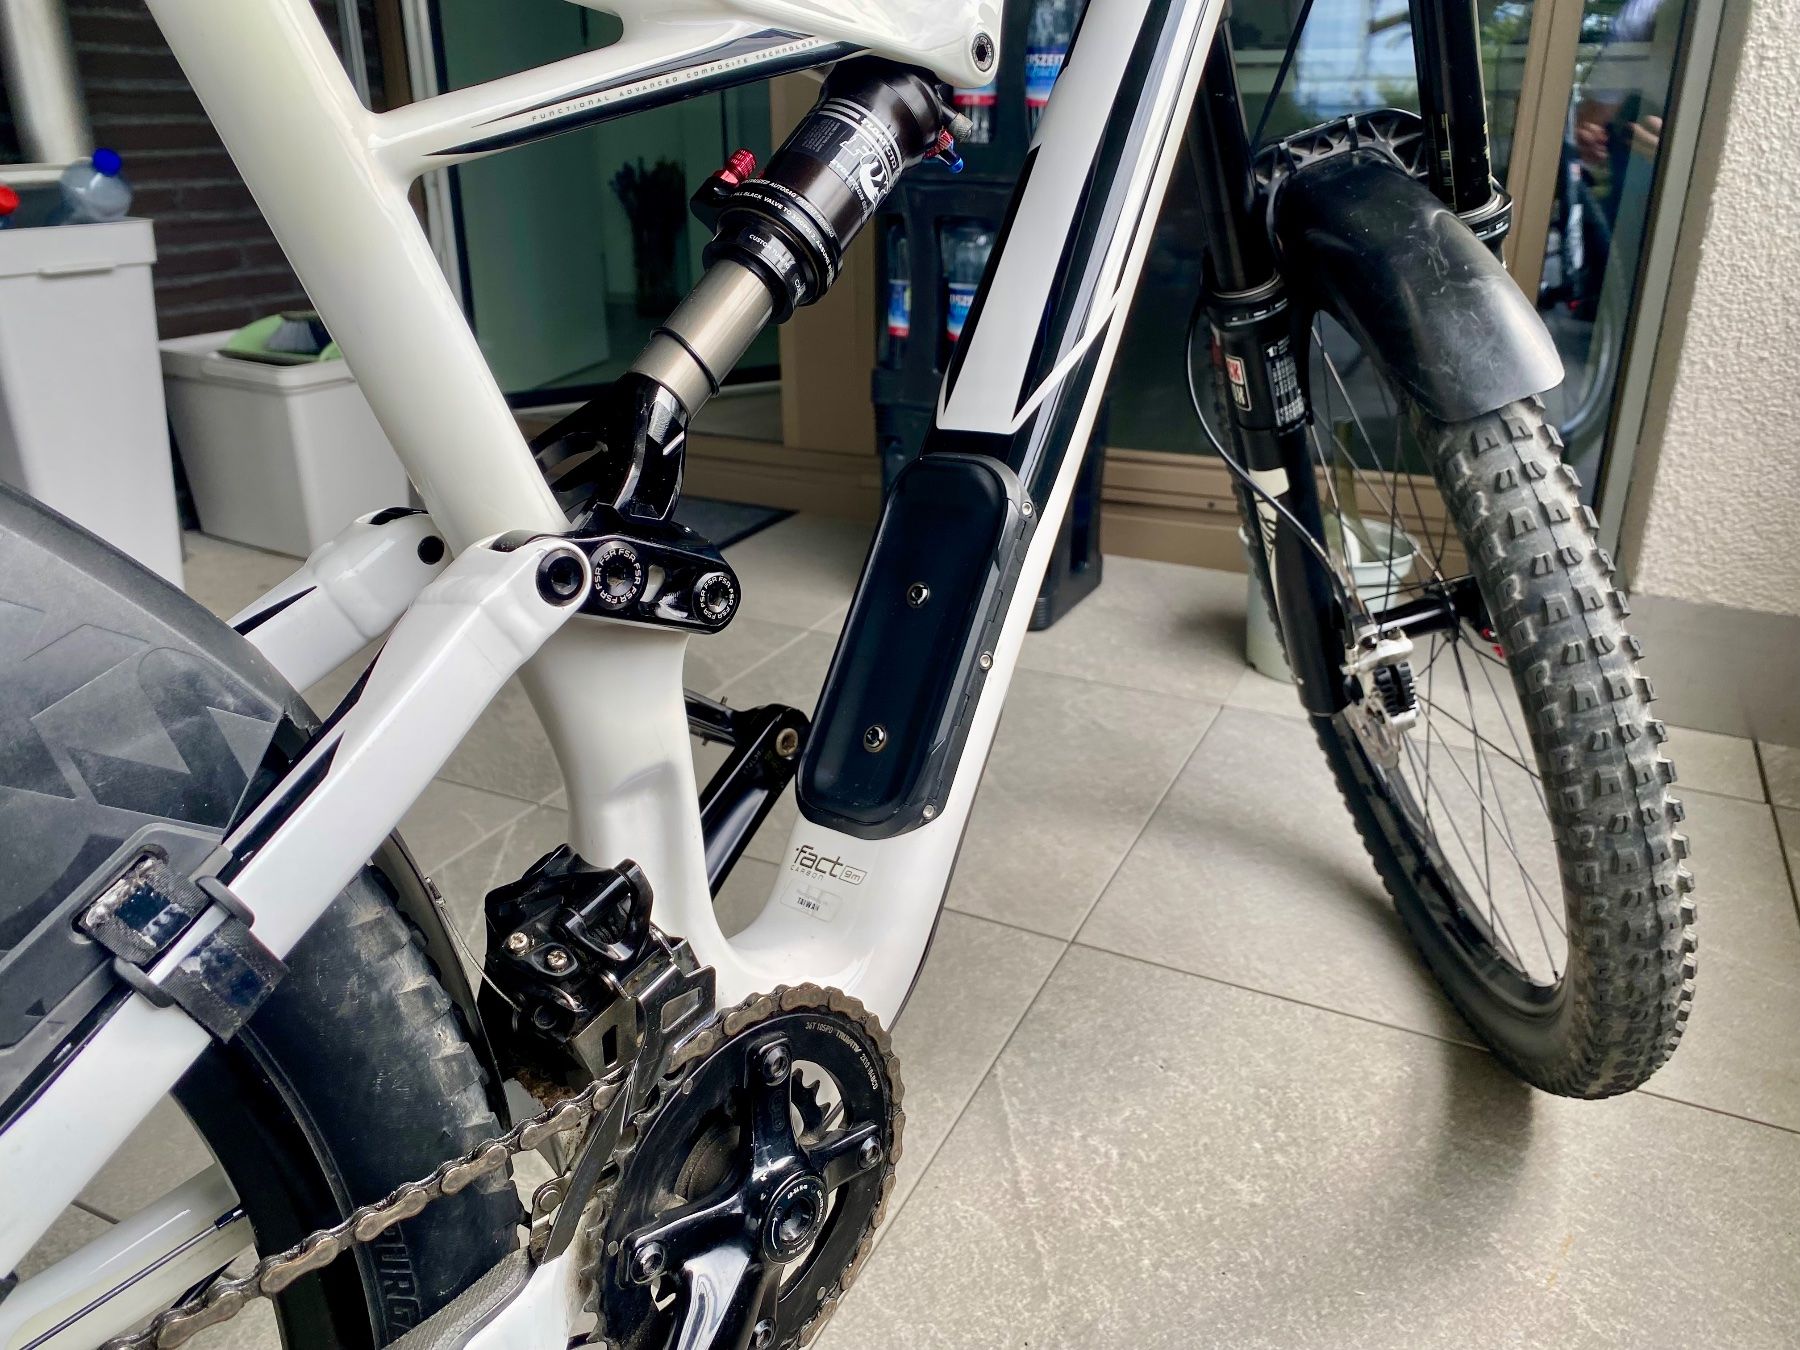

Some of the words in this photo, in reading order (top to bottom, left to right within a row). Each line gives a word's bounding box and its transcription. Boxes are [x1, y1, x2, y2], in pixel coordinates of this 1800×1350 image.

[532, 96, 609, 121] FUNCTIONAL
[619, 76, 678, 97] ADVANCED
[686, 57, 748, 78] COMPOSITE
[755, 39, 820, 60] TECHNOLOGY
[860, 118, 889, 148] FLOAT
[886, 146, 897, 169] CTD
[829, 159, 865, 200] EVOLUTION
[769, 181, 797, 199] AUTOSAG
[763, 196, 783, 210] VALVE
[783, 206, 792, 216] TO
[749, 233, 772, 249] CUSTOM
[599, 549, 617, 566] FSR
[618, 549, 637, 563] FSR
[594, 567, 603, 590] FSR
[633, 562, 642, 585] FSR
[703, 576, 717, 589] FSR
[718, 576, 731, 589] FSR
[600, 590, 618, 604] FSR
[620, 585, 637, 603] FSR
[703, 607, 716, 620] FSR
[717, 605, 730, 619] FSR
[794, 845, 843, 878] fact
[790, 864, 824, 880] CARBON
[797, 896, 820, 912] TAIWAN
[835, 1029, 862, 1053] TRUVATIV
